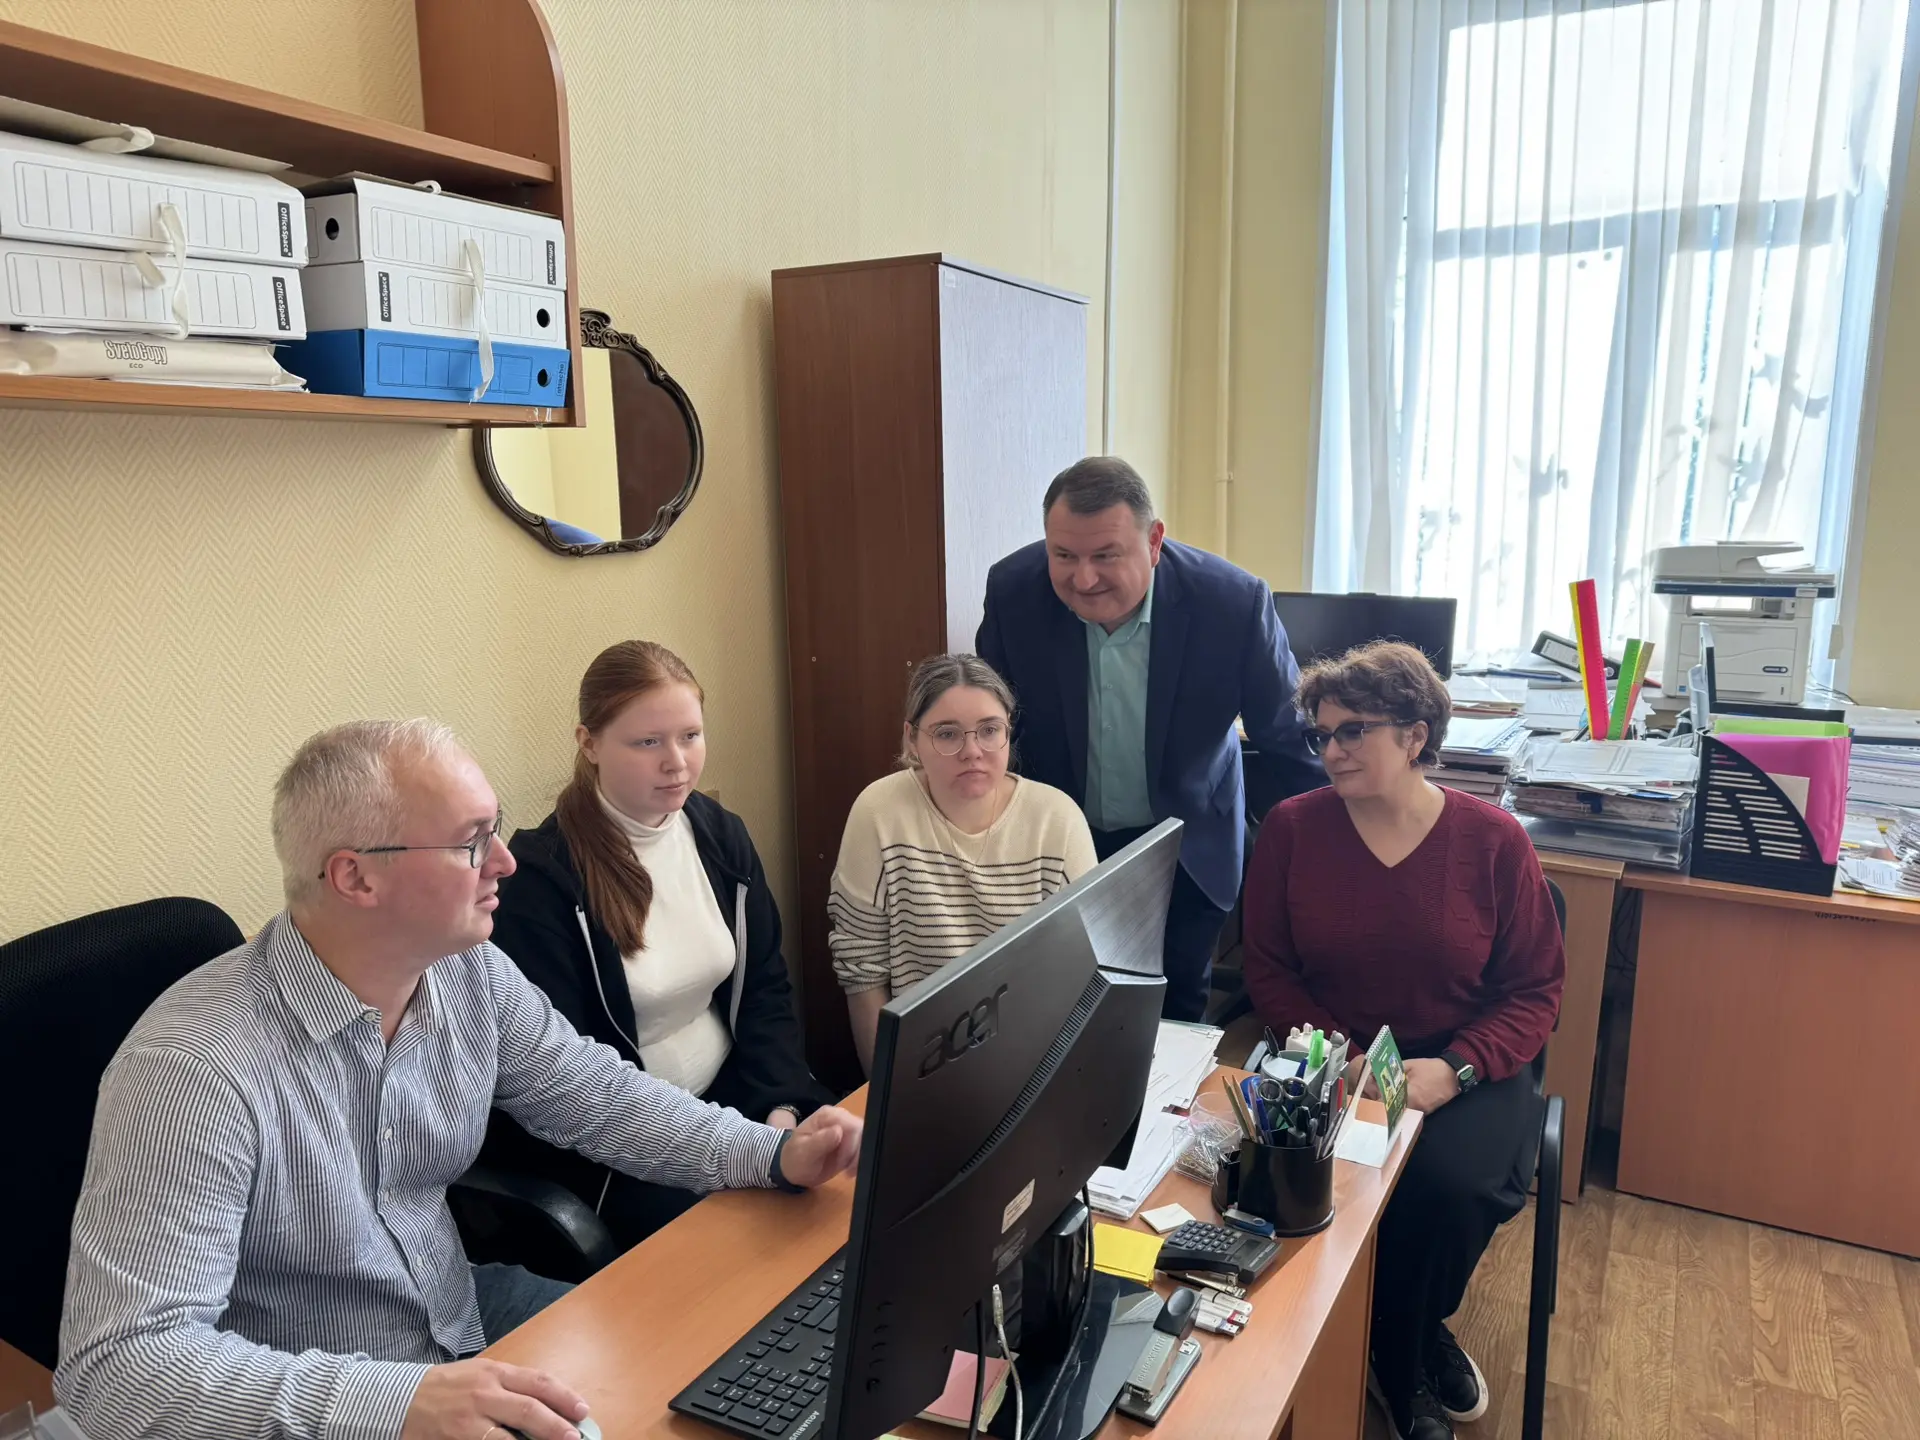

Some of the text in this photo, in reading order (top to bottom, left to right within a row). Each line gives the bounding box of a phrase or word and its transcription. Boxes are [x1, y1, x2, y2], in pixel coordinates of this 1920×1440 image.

[280, 206, 290, 254] OfficeSpace
[275, 280, 288, 328] OfficeSpace
[381, 274, 390, 318] OfficeSpace
[103, 340, 167, 365] SvetoCopy
[917, 983, 1008, 1080] acer
